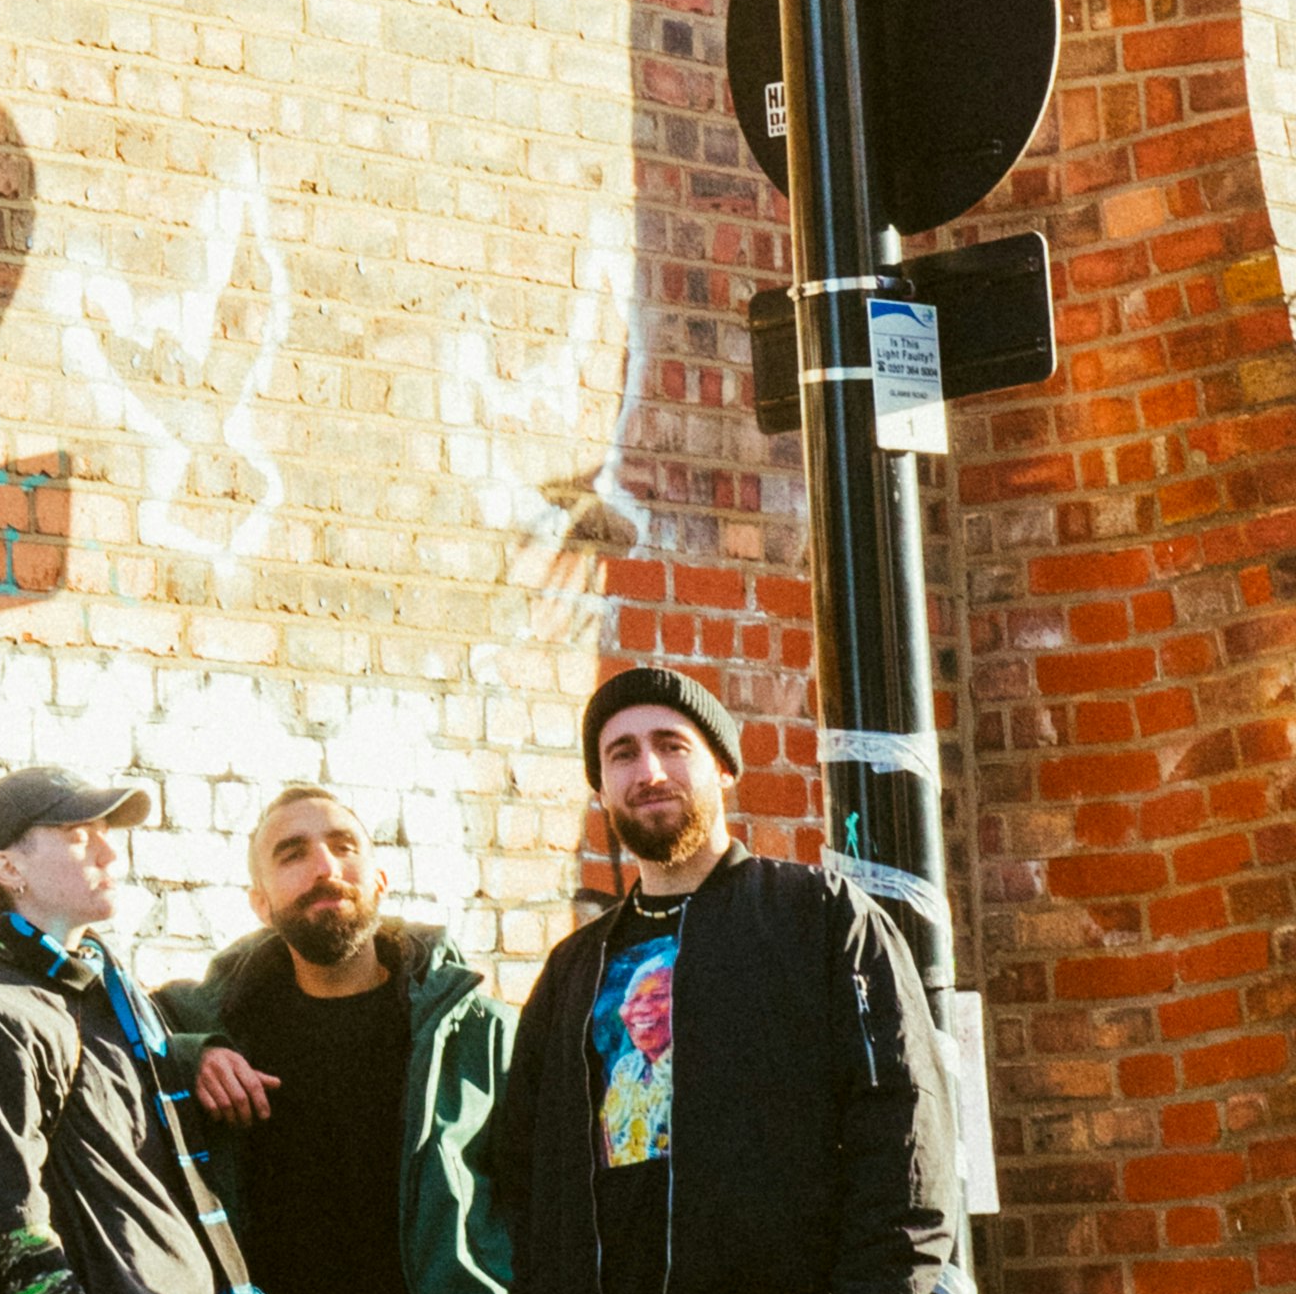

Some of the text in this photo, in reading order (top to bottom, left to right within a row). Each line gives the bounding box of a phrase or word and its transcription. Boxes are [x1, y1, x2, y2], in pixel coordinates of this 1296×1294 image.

[901, 337, 919, 350] This
[877, 348, 934, 365] Light Faulty?
